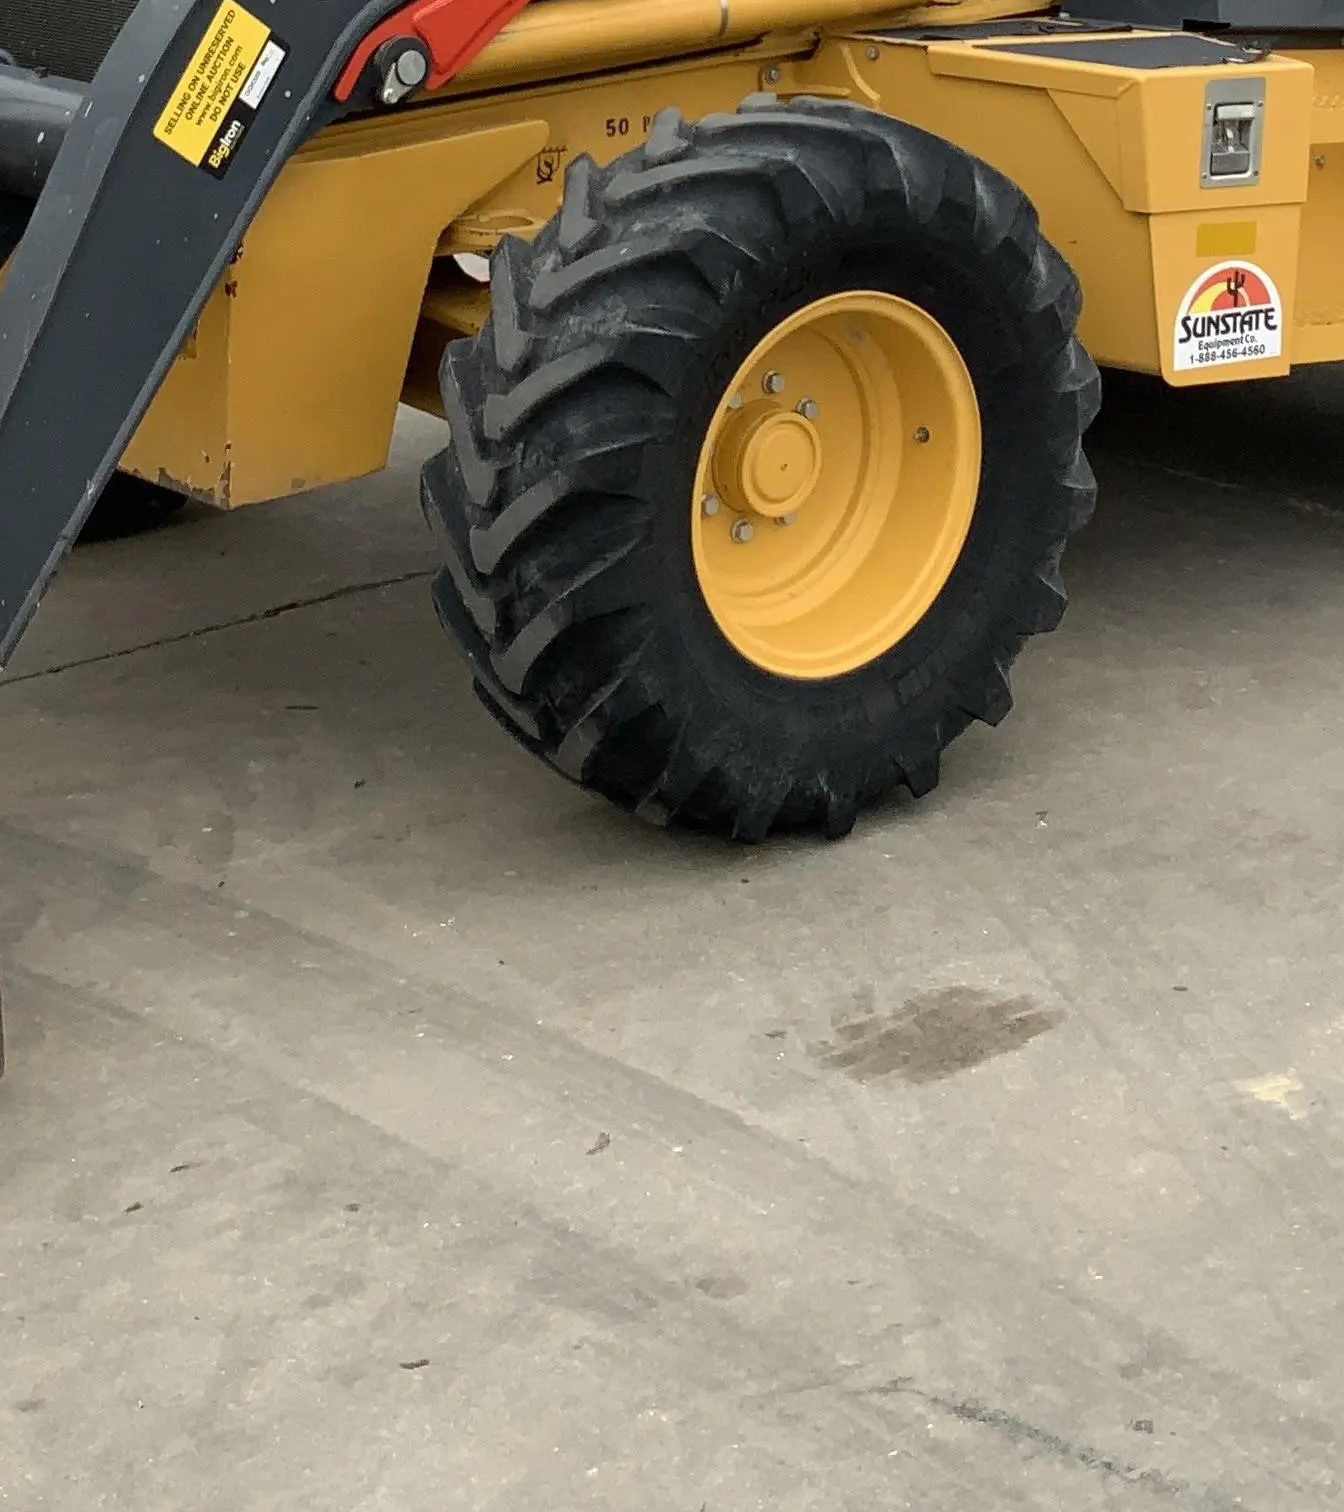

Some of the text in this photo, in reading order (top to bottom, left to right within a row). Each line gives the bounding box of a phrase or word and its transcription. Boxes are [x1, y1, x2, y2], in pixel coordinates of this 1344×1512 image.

[164, 9, 236, 135] SELLING ON UNRESERVED
[185, 37, 235, 121] ONLINE AUCTION
[195, 45, 243, 126] www.bigiron.com
[210, 62, 246, 122] DO NOT USE
[208, 120, 241, 169] BigIron
[606, 118, 629, 137] 50
[1179, 308, 1278, 344] SUNSTATE
[1198, 337, 1243, 351] Equipment
[1190, 345, 1265, 364] 1-888-456-4560
